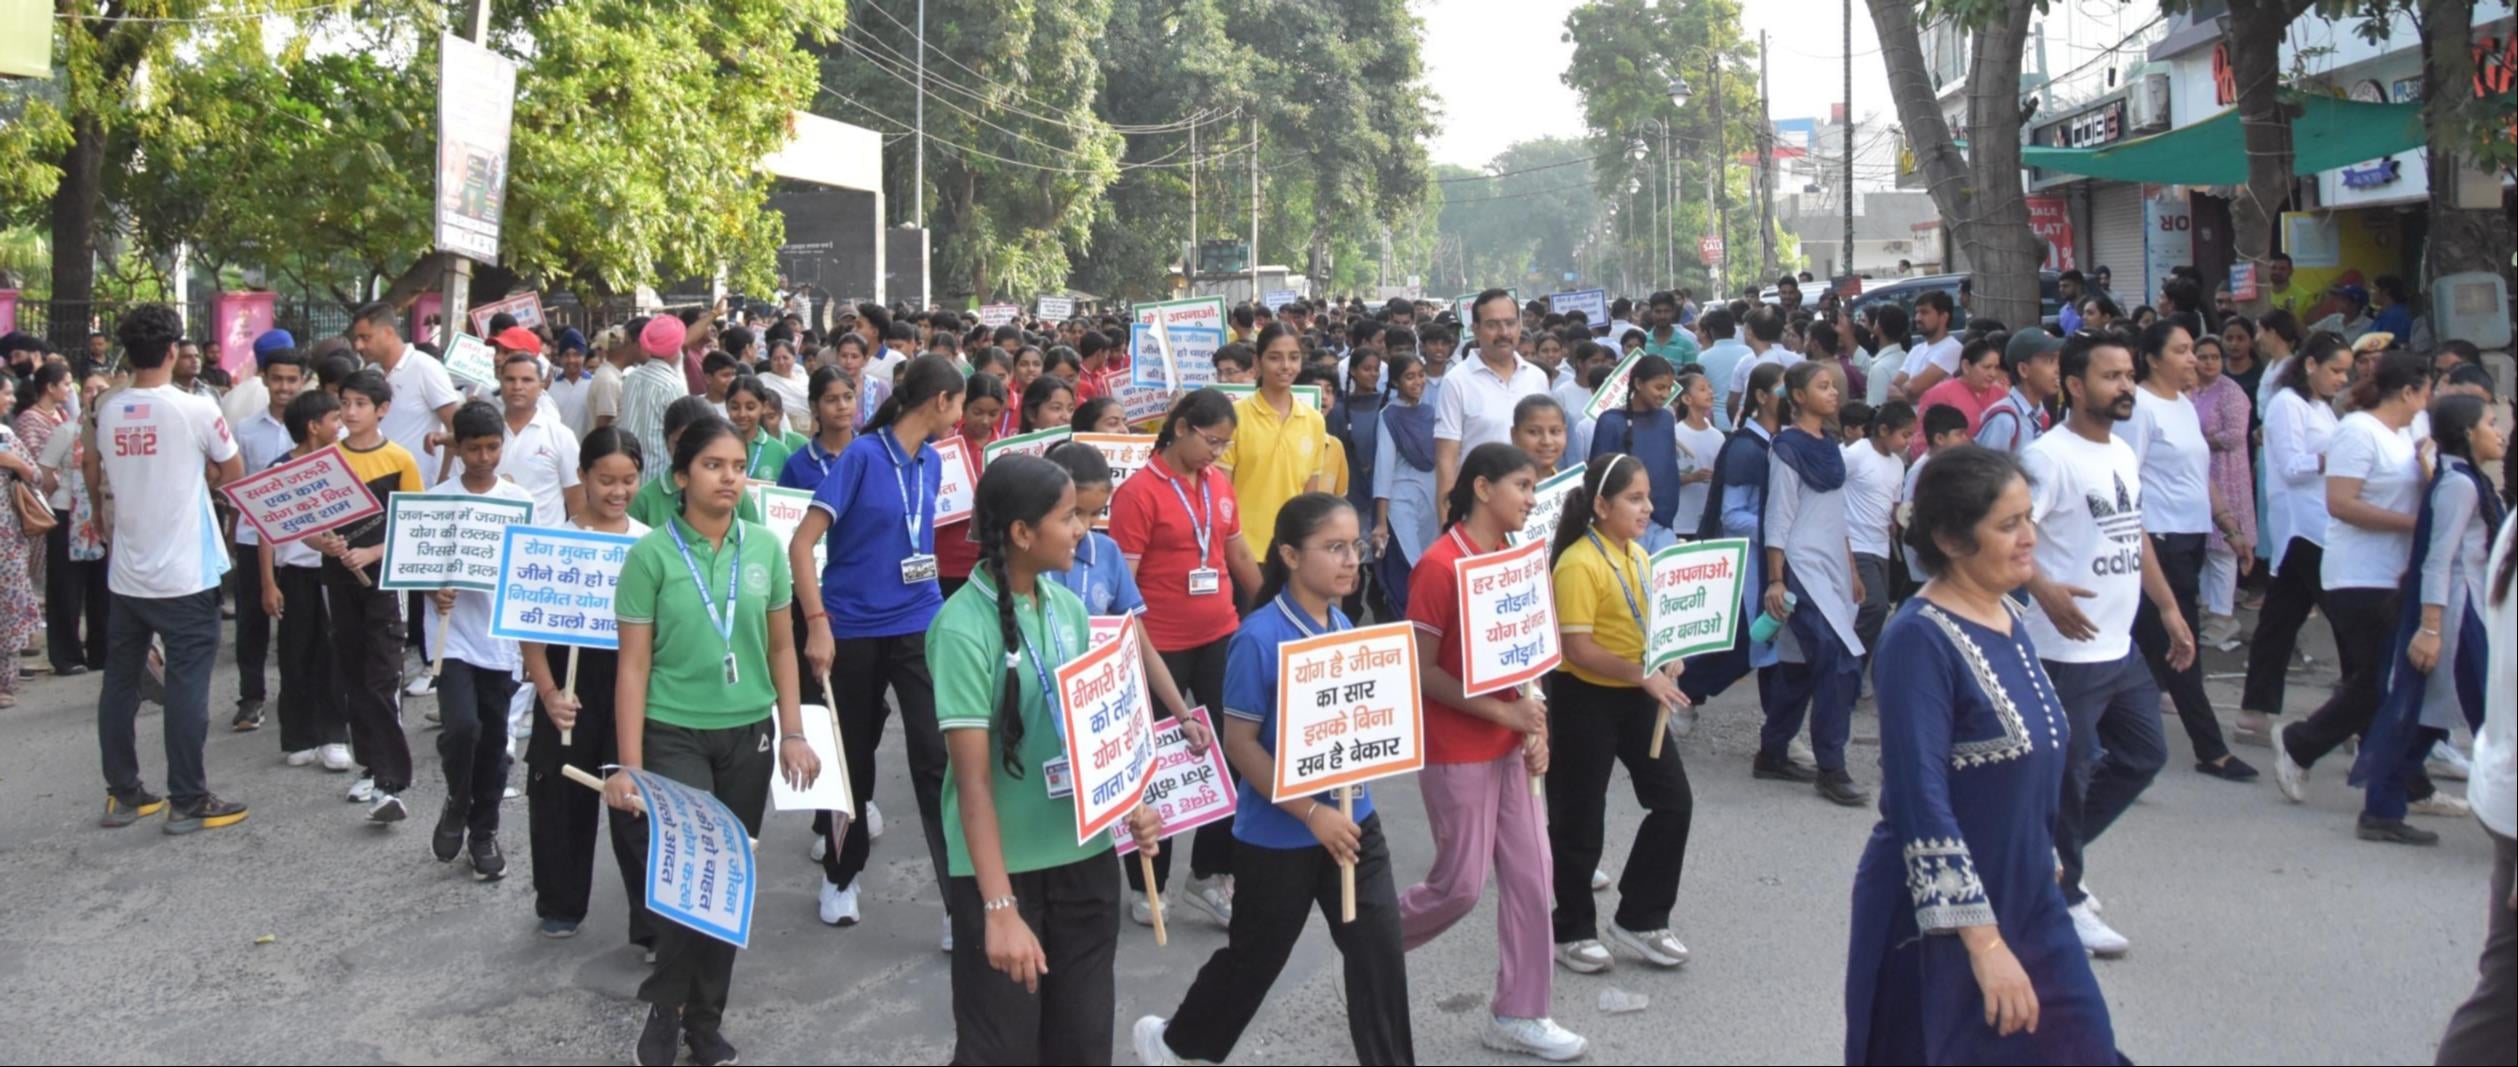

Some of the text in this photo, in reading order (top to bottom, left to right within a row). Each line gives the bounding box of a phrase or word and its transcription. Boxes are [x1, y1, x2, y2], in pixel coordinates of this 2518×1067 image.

[244, 476, 284, 500] सबसे
[264, 476, 331, 508] एक काम
[262, 507, 293, 524] योग
[318, 499, 352, 519] शाम
[398, 510, 455, 522] जन-जन
[457, 506, 475, 521] में
[409, 523, 502, 543] योग की ललक
[446, 558, 464, 574] की
[524, 538, 554, 557] रोग
[558, 544, 598, 566] मुक्त
[516, 562, 553, 583] जीने
[557, 566, 581, 586] की
[584, 570, 604, 588] हो
[1472, 574, 1494, 595] हर
[1498, 566, 1523, 589] रोग
[508, 584, 610, 611] नियमित योग
[520, 606, 544, 626] की
[547, 612, 586, 630] डालो
[1486, 620, 1518, 643] योग
[1295, 645, 1404, 685] योग है जीवन
[1315, 679, 1377, 709] का सार
[1088, 701, 1111, 735] को
[1303, 703, 1395, 747] इसके बिना
[1092, 738, 1122, 770] योग
[1297, 736, 1402, 778] सब है बेकार
[1091, 769, 1126, 807] नाता
[1180, 765, 1215, 785] रोज
[681, 821, 698, 858] योग
[701, 833, 719, 856] हो
[661, 830, 677, 887] आदत
[699, 859, 717, 913] चाहत
[724, 858, 745, 917] जीवन
